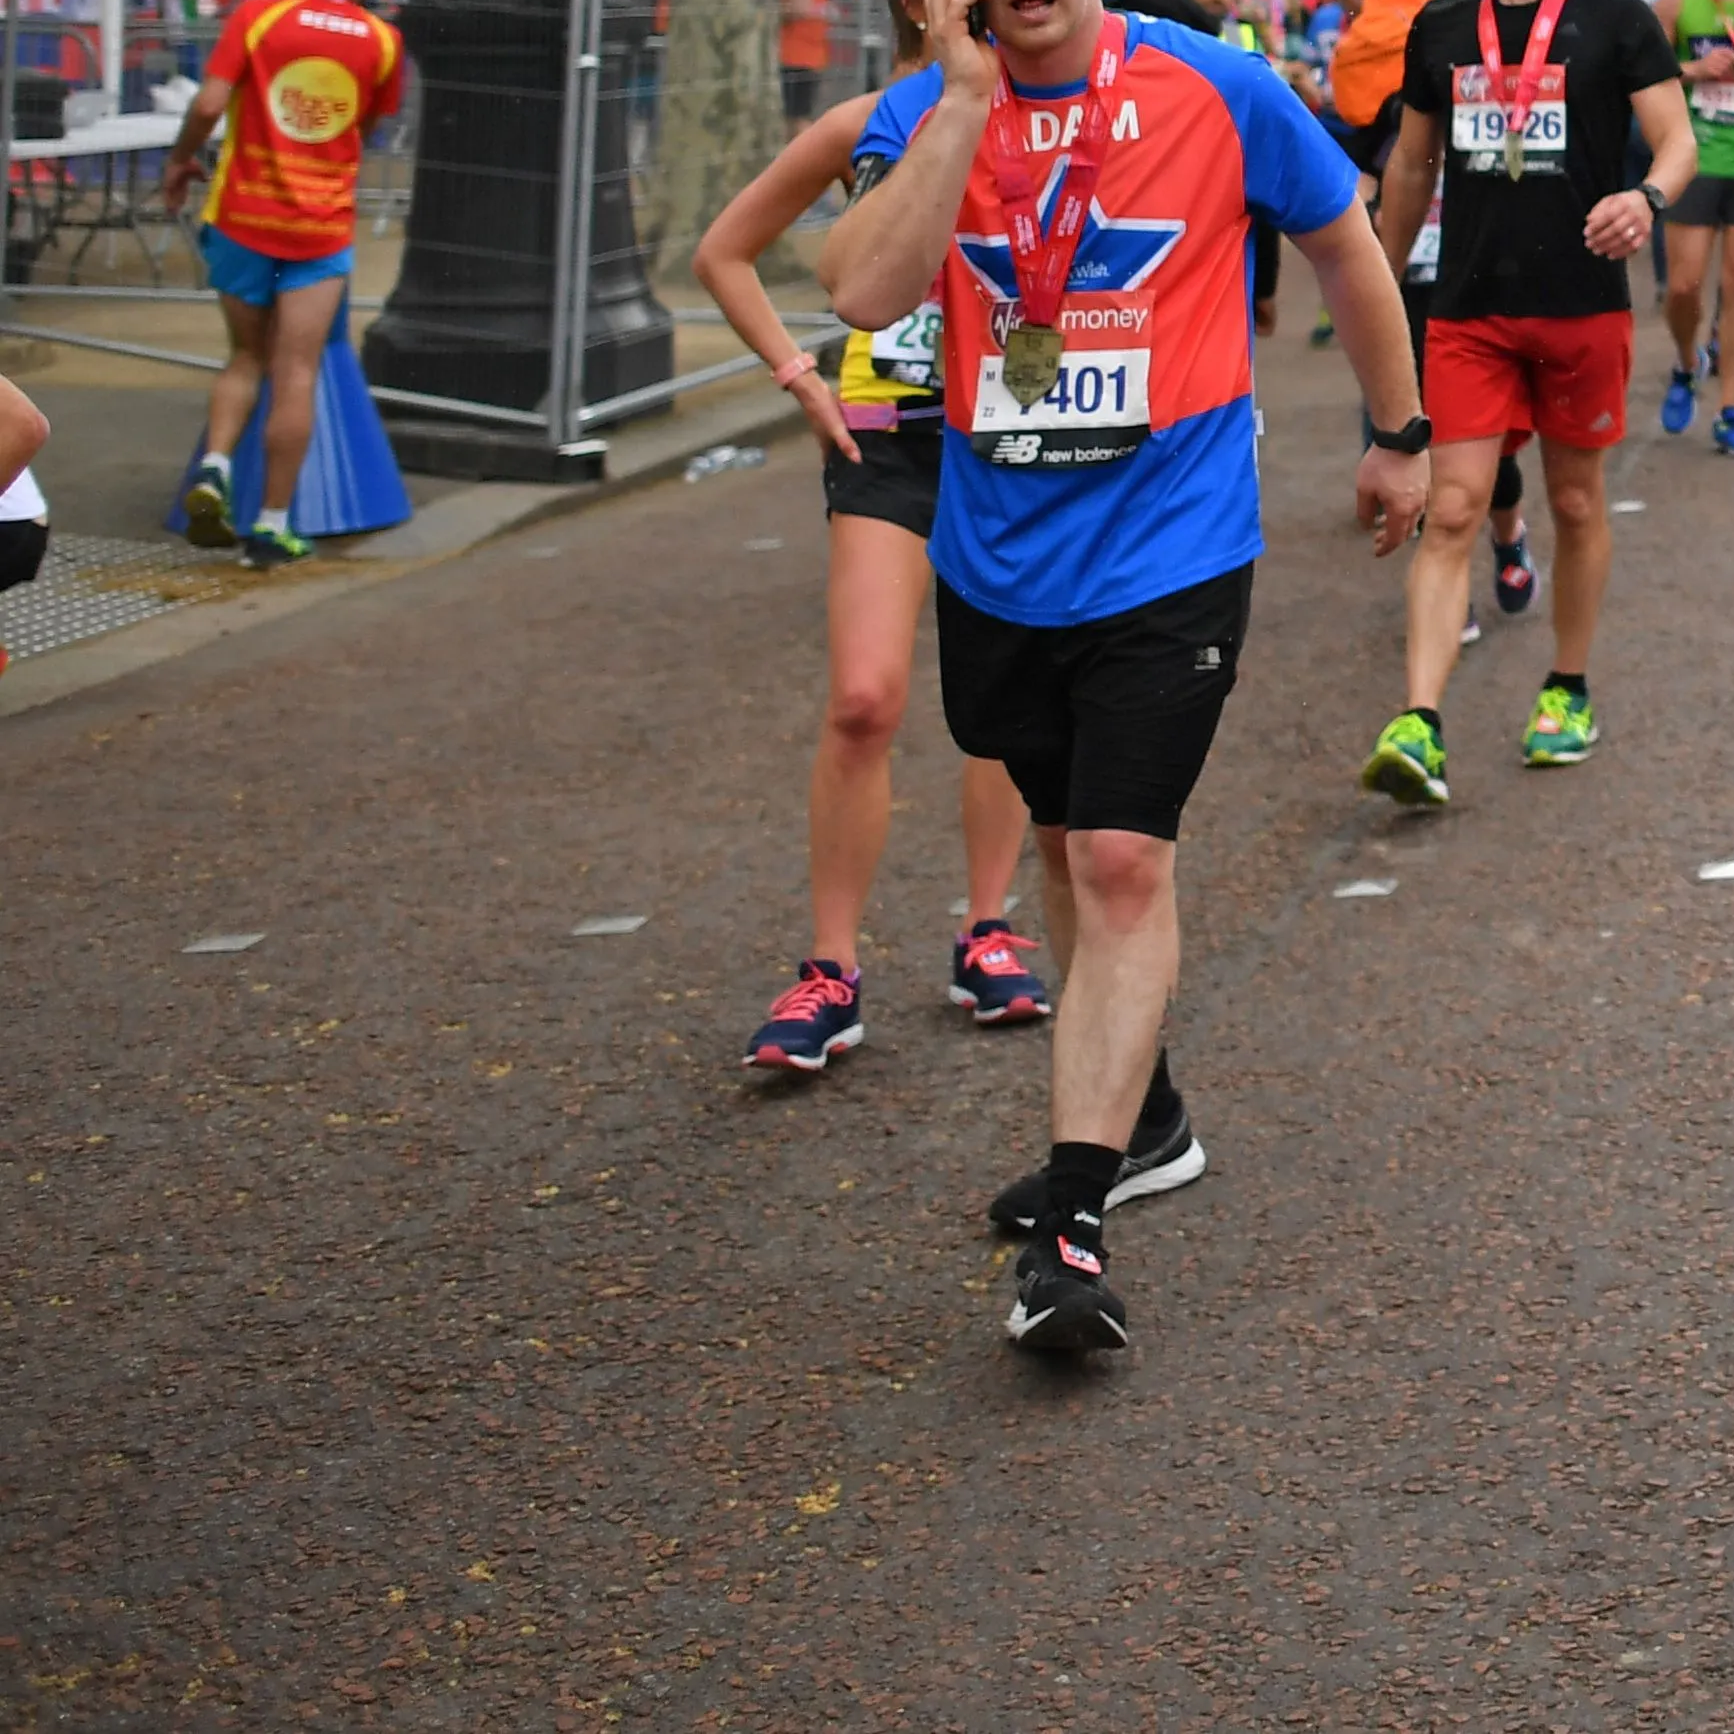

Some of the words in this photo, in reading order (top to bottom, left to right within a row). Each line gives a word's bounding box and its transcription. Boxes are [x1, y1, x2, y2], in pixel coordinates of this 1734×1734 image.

[1022, 99, 1141, 153] DAM
[1468, 110, 1562, 141] 1926
[1060, 307, 1148, 333] money
[1042, 448, 1072, 462] new
[1074, 444, 1137, 462] balance
